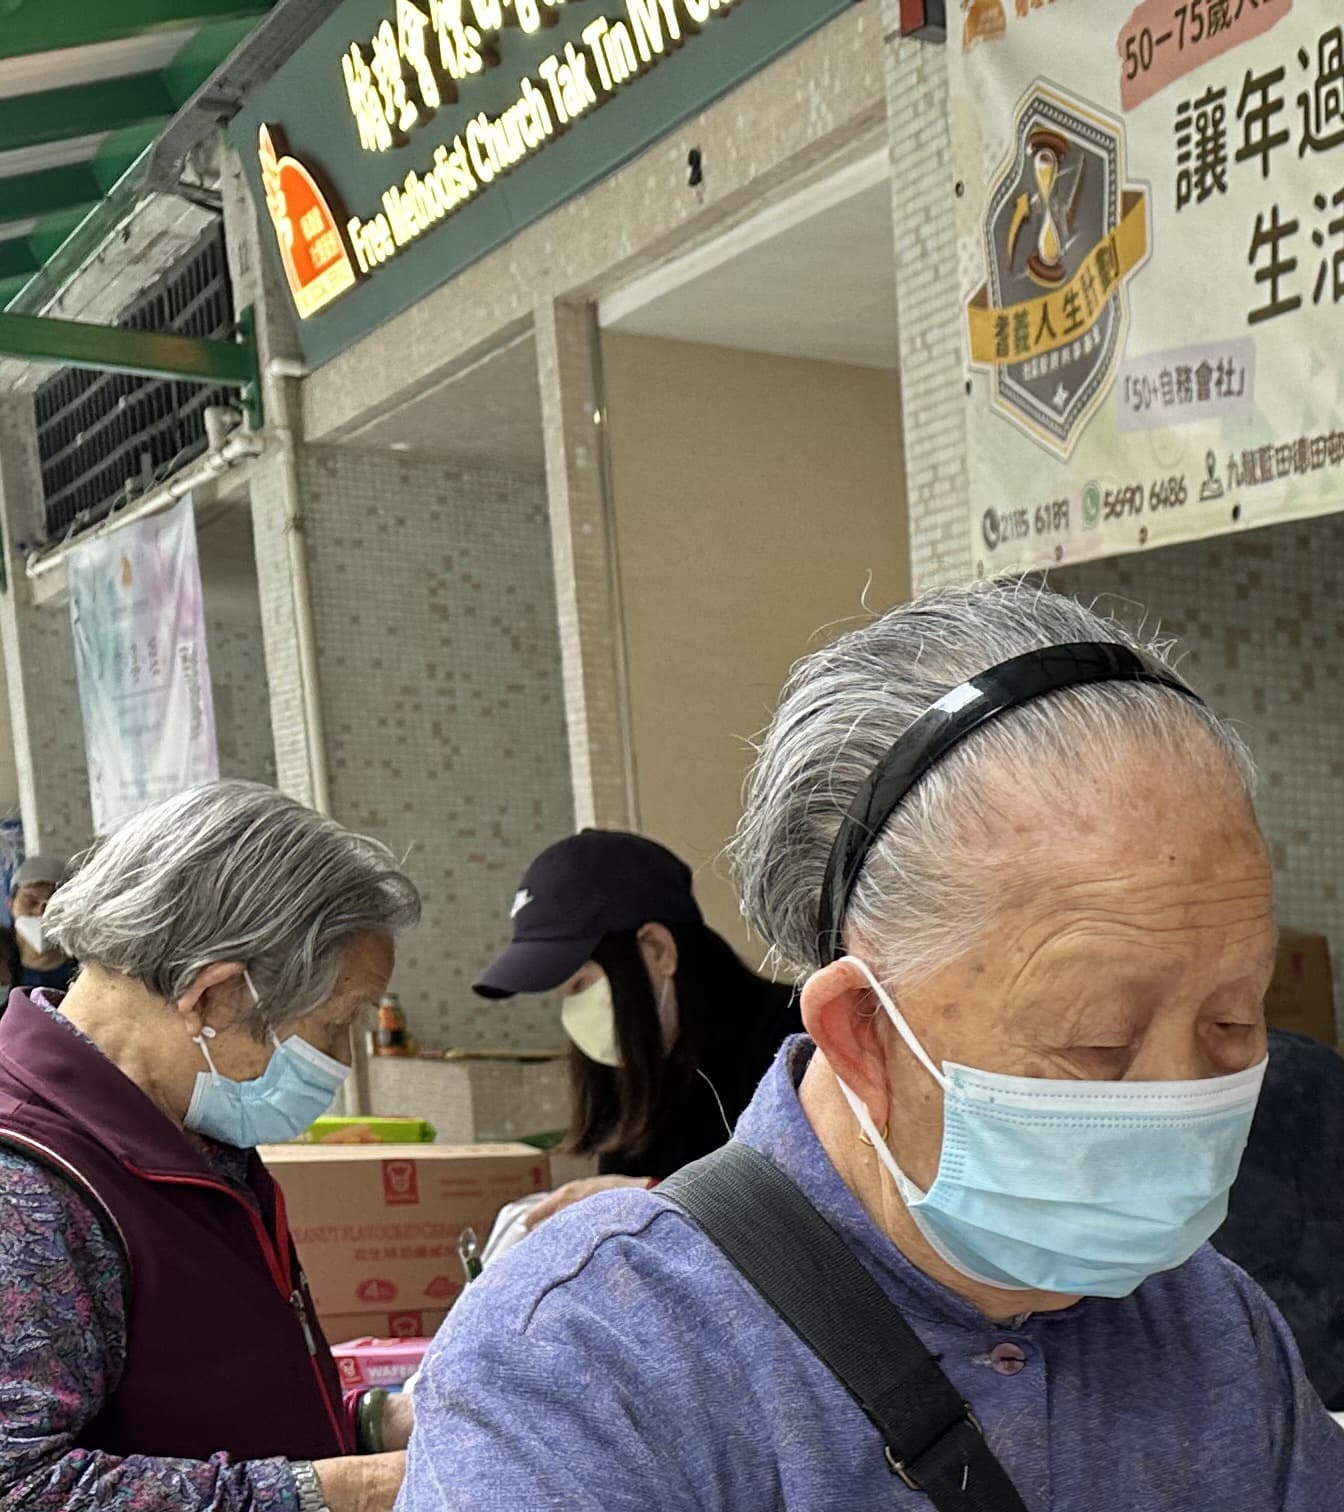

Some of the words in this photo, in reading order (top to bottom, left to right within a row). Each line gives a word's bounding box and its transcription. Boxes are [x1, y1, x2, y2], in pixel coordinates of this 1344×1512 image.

[347, 213, 396, 272] Free
[382, 135, 477, 246] Methodist
[466, 77, 553, 183] Church
[538, 41, 597, 124] Tak
[582, 16, 638, 91] Tin
[1102, 485, 1145, 520] 5690
